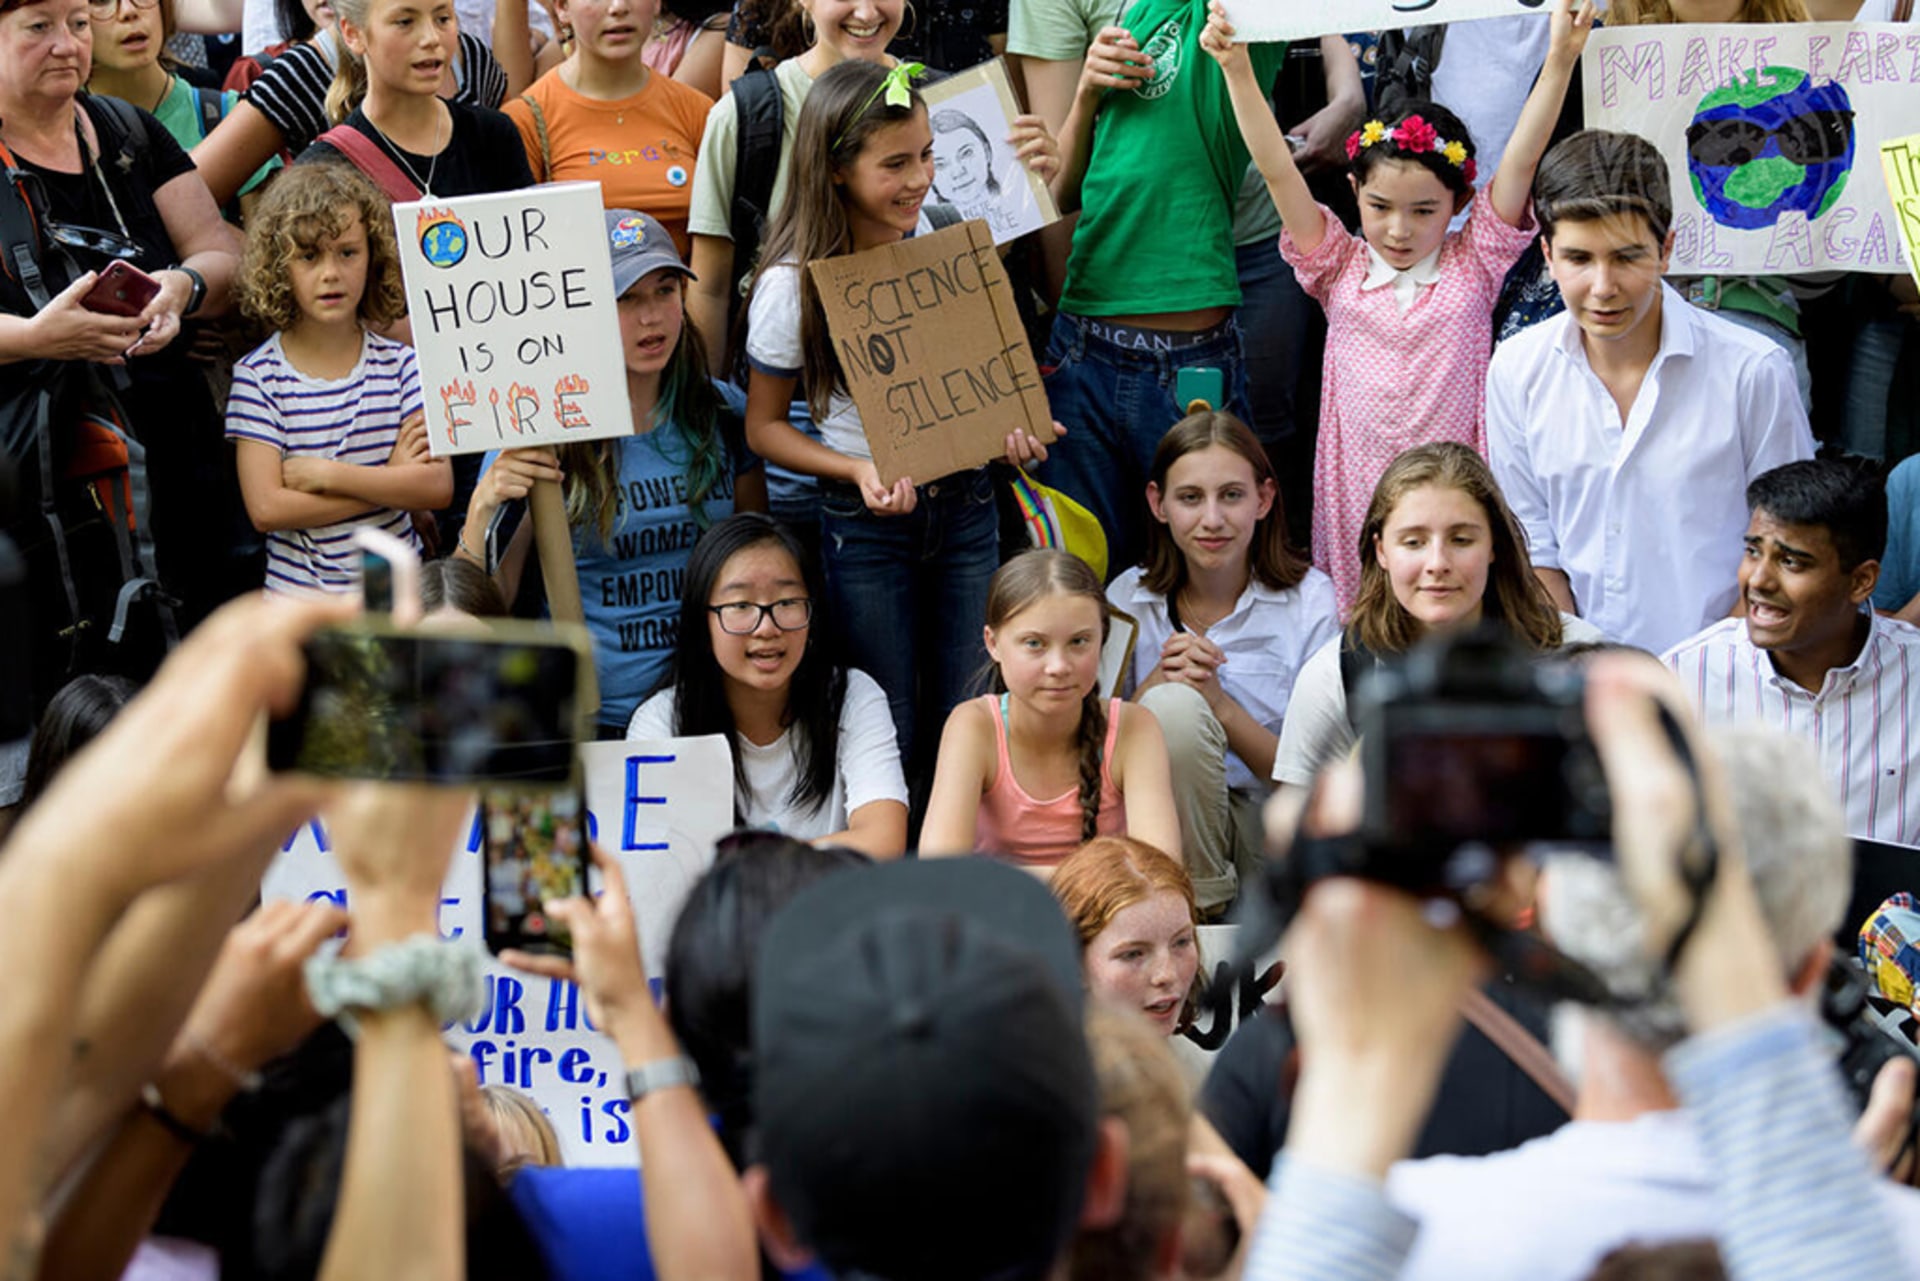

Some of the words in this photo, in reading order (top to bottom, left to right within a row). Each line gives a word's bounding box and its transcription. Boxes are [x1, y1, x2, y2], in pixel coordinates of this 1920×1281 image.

[1601, 36, 1777, 108] MAKE
[419, 207, 549, 269] OUR
[1676, 211, 1734, 269] OL
[1764, 207, 1908, 269] AGA
[424, 268, 592, 333] HOUSE
[844, 245, 1001, 330] SCIENCE
[459, 342, 494, 373] IS
[517, 333, 565, 365] ON
[841, 324, 912, 382] NOT
[440, 374, 592, 447] FIRE
[885, 341, 1038, 437] SILENCE
[440, 974, 526, 1035] UR
[470, 1039, 607, 1089] fire,
[581, 1096, 632, 1144] is
